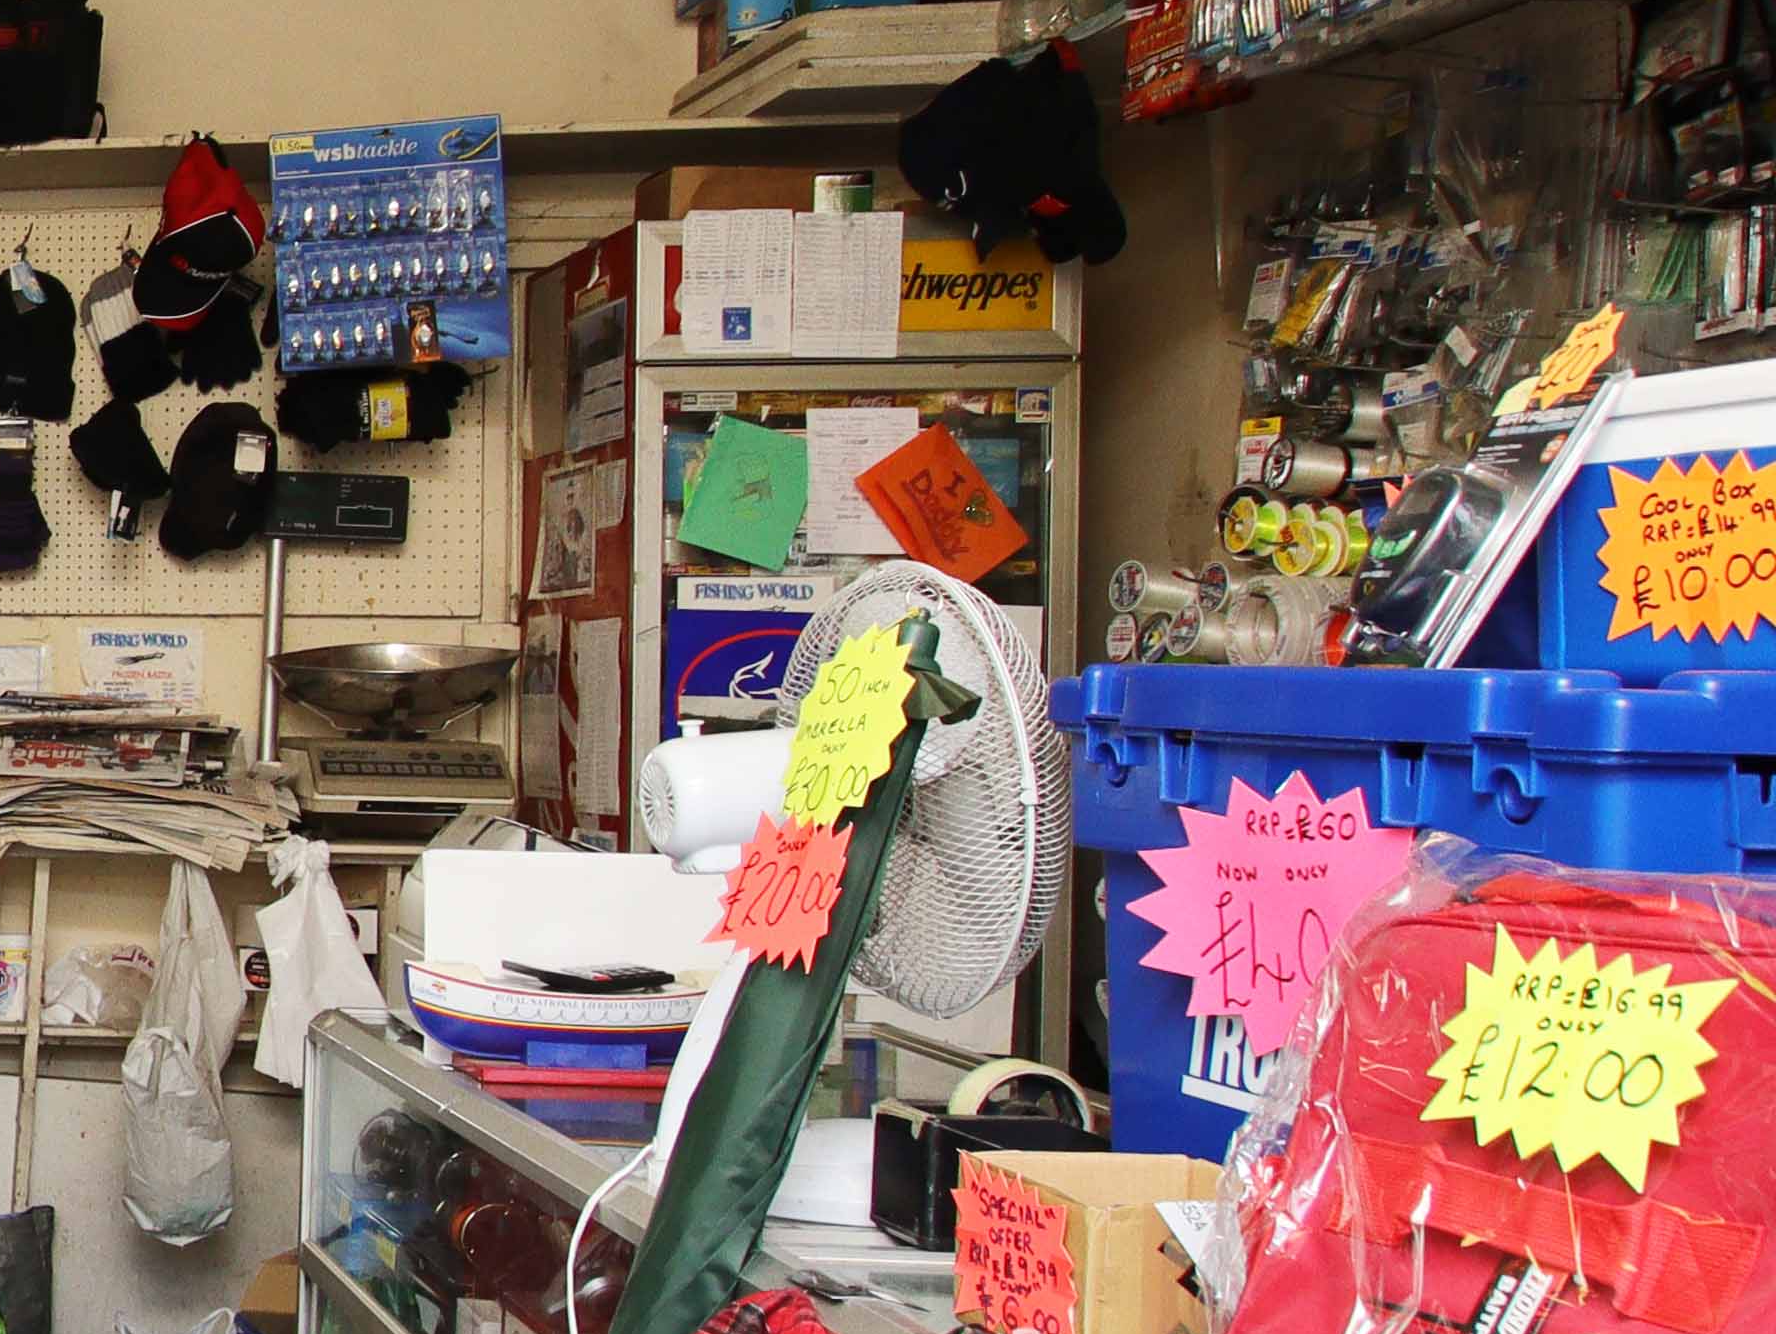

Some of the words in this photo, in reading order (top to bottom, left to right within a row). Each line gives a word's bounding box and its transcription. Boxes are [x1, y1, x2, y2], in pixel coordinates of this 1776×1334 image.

[313, 139, 419, 164] wsbtackle
[1640, 493, 1694, 520] COOL
[1675, 545, 1713, 564] ONLY
[694, 583, 753, 600] FISHING
[756, 582, 815, 599] WORLD
[1633, 548, 1776, 619] £10.00
[91, 632, 140, 648] FISHING
[141, 632, 189, 649] WORLD
[819, 662, 862, 707] 50
[862, 680, 891, 698] INCH
[1216, 863, 1259, 882] NOW
[1285, 862, 1329, 880] ONLY
[720, 851, 837, 936] £20.00
[1537, 1017, 1604, 1033] ONLY
[1460, 1023, 1665, 1108] £12.00
[988, 1227, 1034, 1254] OFFER
